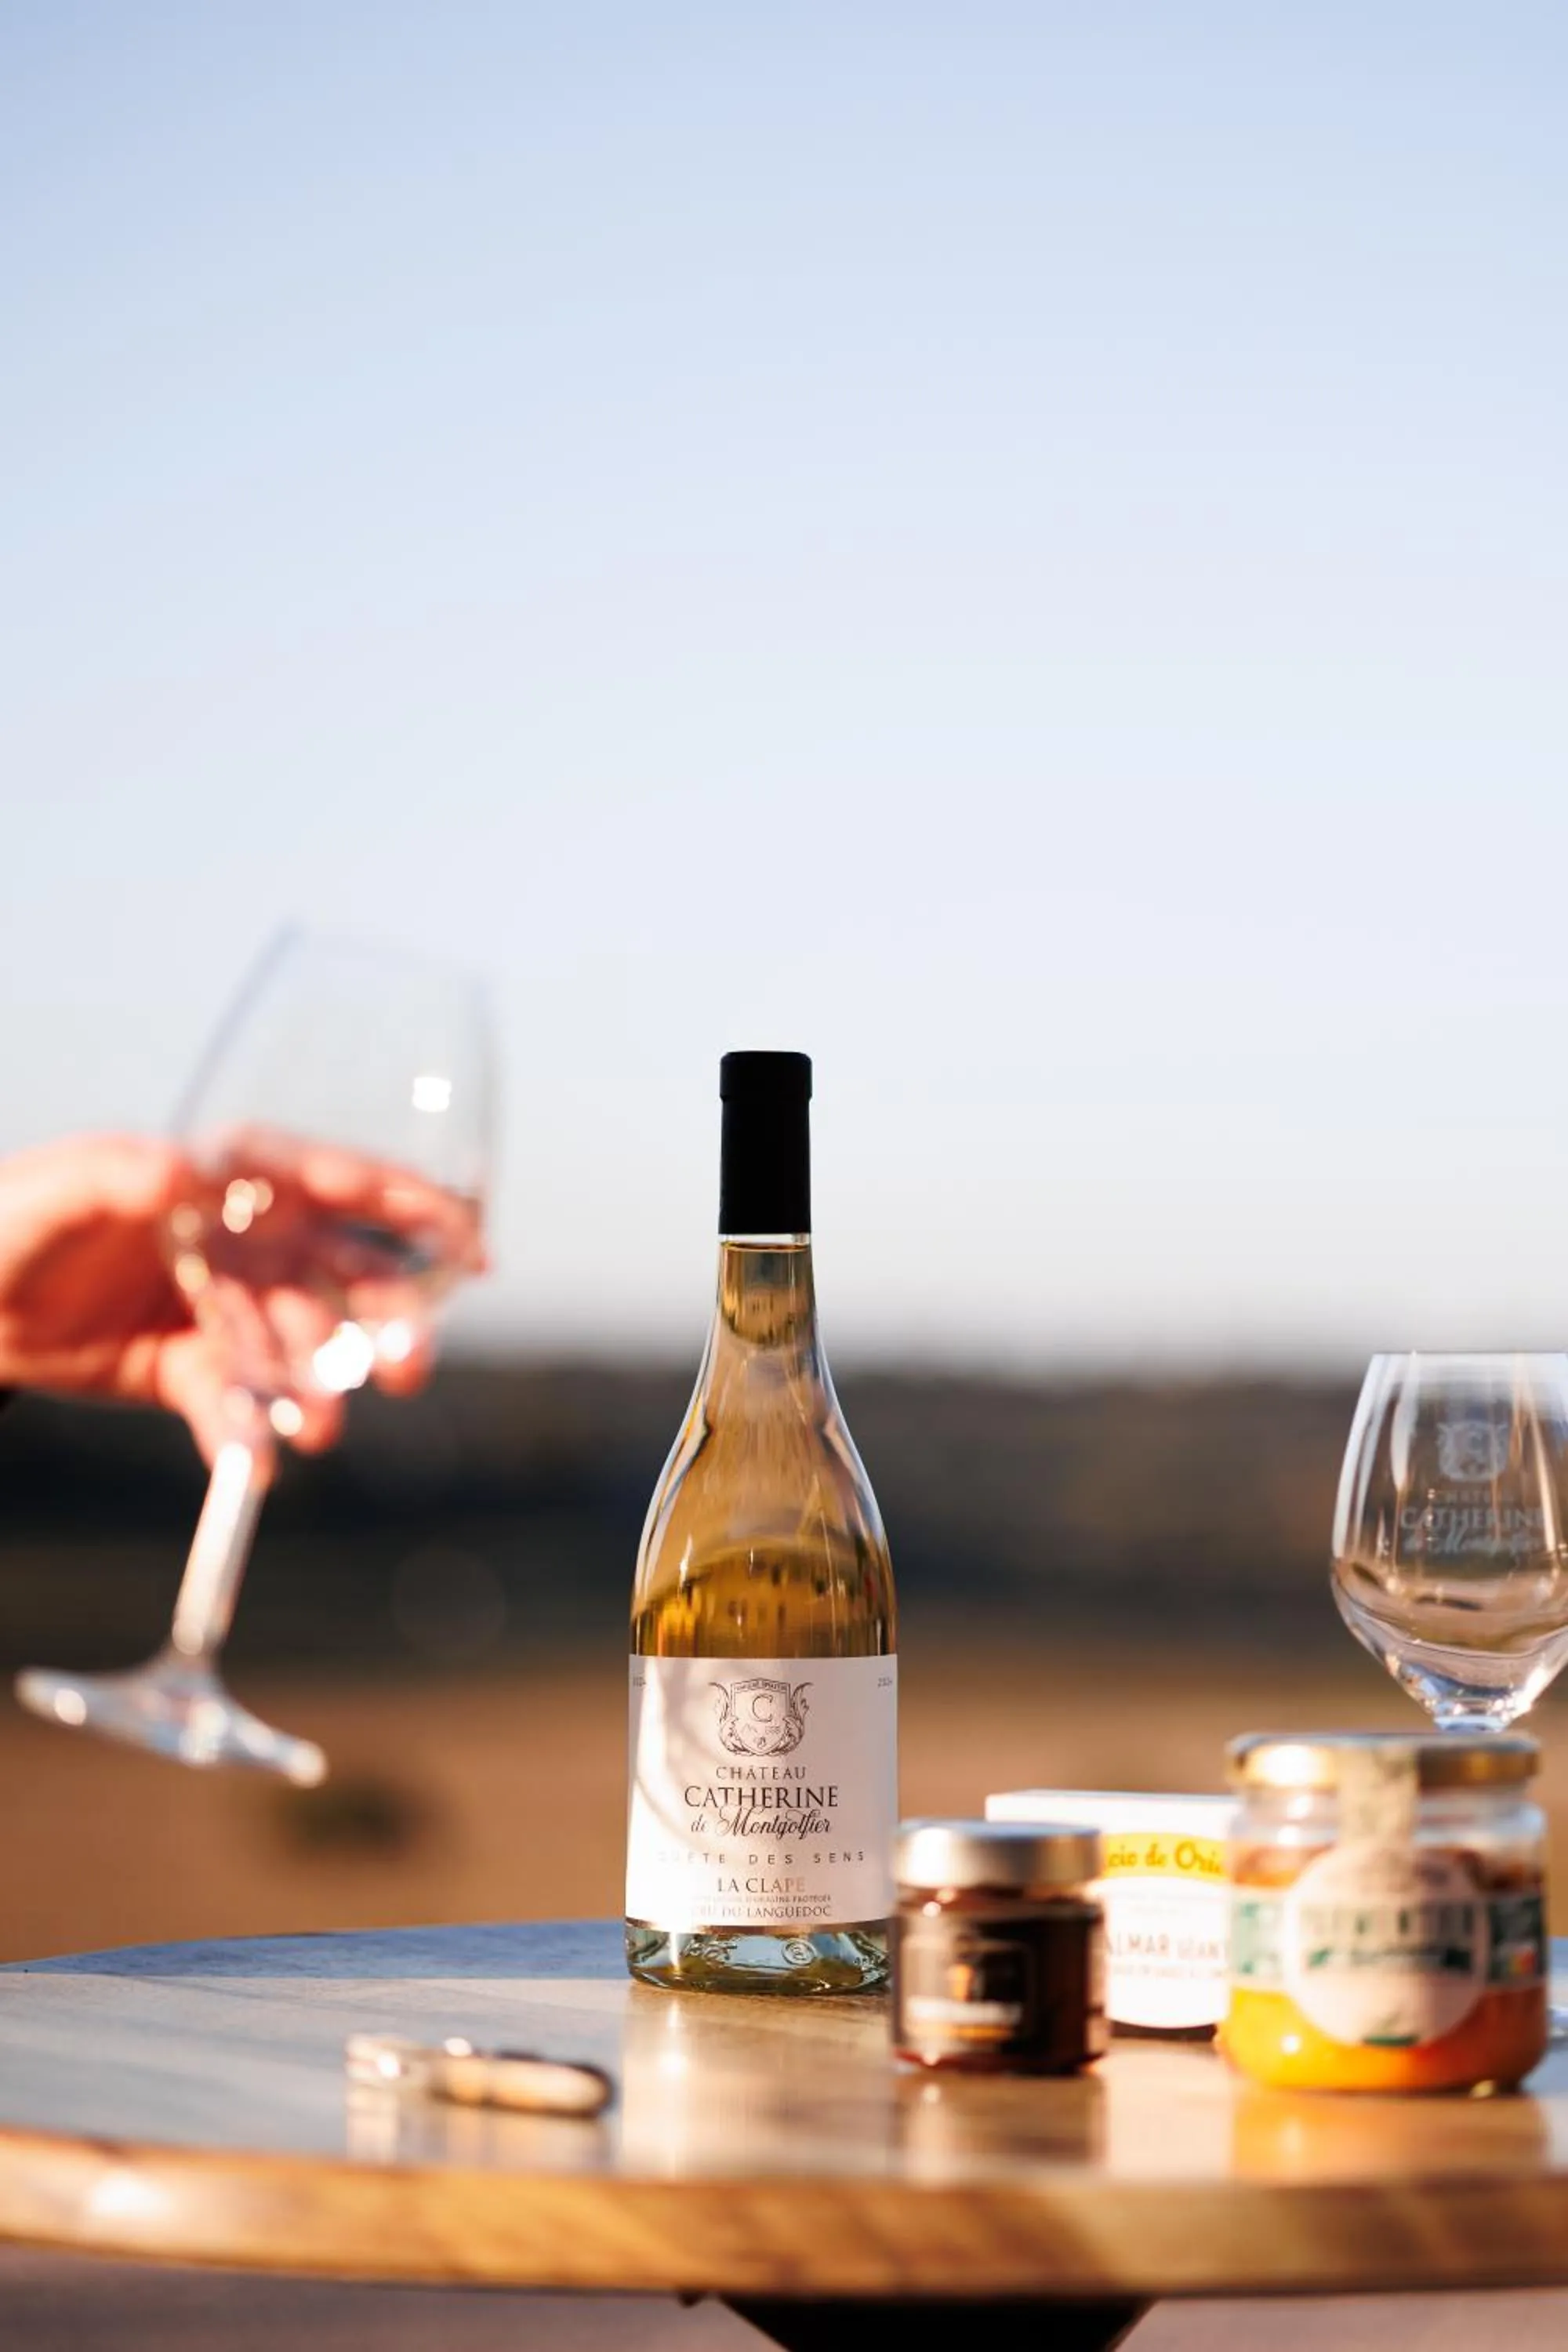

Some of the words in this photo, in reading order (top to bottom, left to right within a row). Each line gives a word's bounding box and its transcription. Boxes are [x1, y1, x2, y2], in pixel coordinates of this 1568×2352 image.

[752, 1693, 774, 1722] C
[684, 1785, 839, 1809] CATHERINE
[690, 1813, 710, 1833] de
[714, 1805, 831, 1840] Montgolfier
[748, 1853, 793, 1865] DES
[812, 1850, 865, 1864] SENS
[717, 1878, 739, 1893] LA
[745, 1877, 806, 1893] CLAPE
[722, 1906, 742, 1918] DU
[746, 1904, 833, 1918] LANGUEDOC
